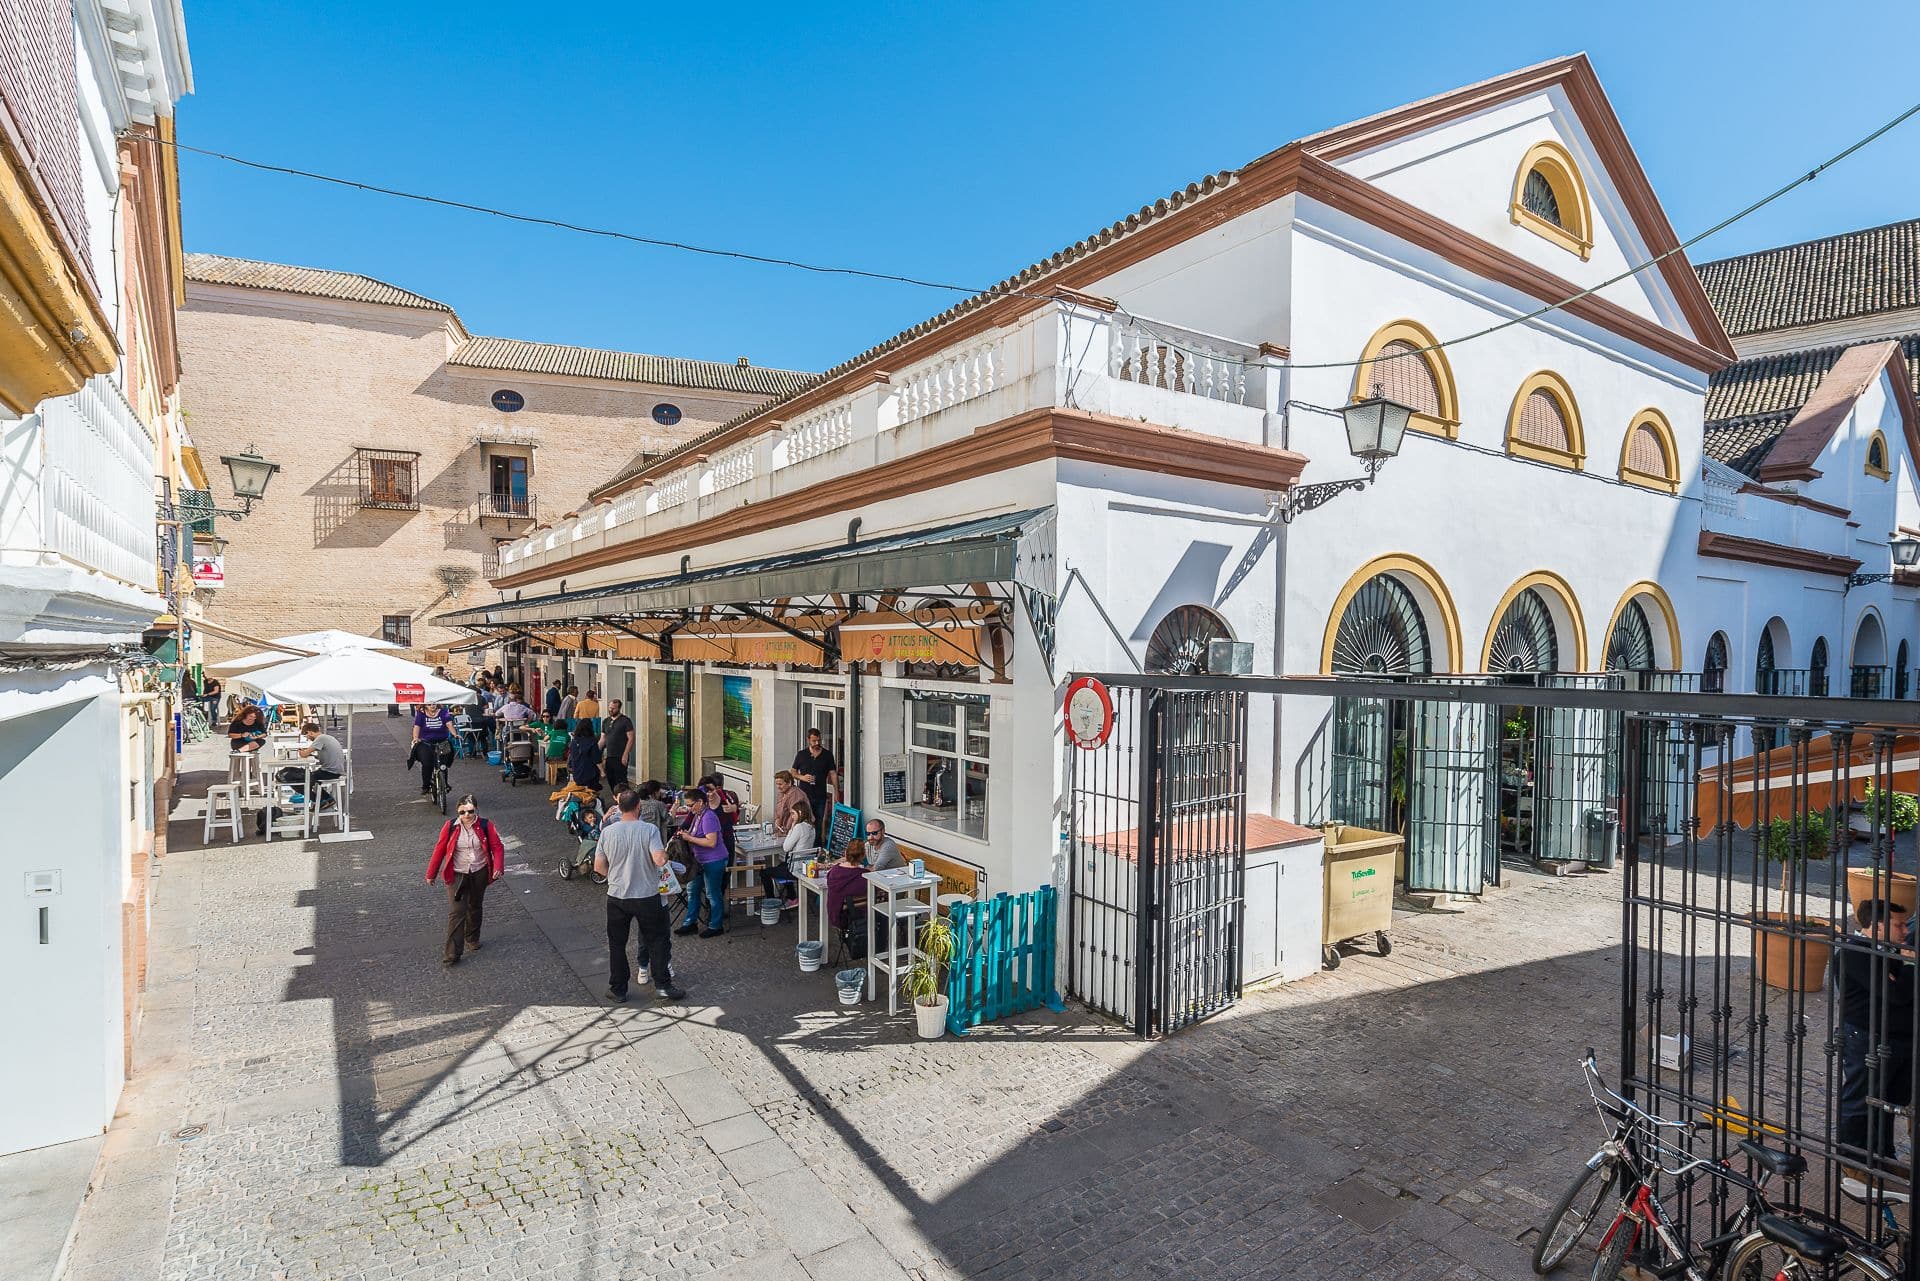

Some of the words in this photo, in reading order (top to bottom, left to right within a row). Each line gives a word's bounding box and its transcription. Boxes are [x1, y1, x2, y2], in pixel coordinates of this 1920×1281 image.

[889, 636, 916, 647] ATTICUS
[918, 635, 938, 647] FINCH
[946, 876, 970, 894] FINCH
